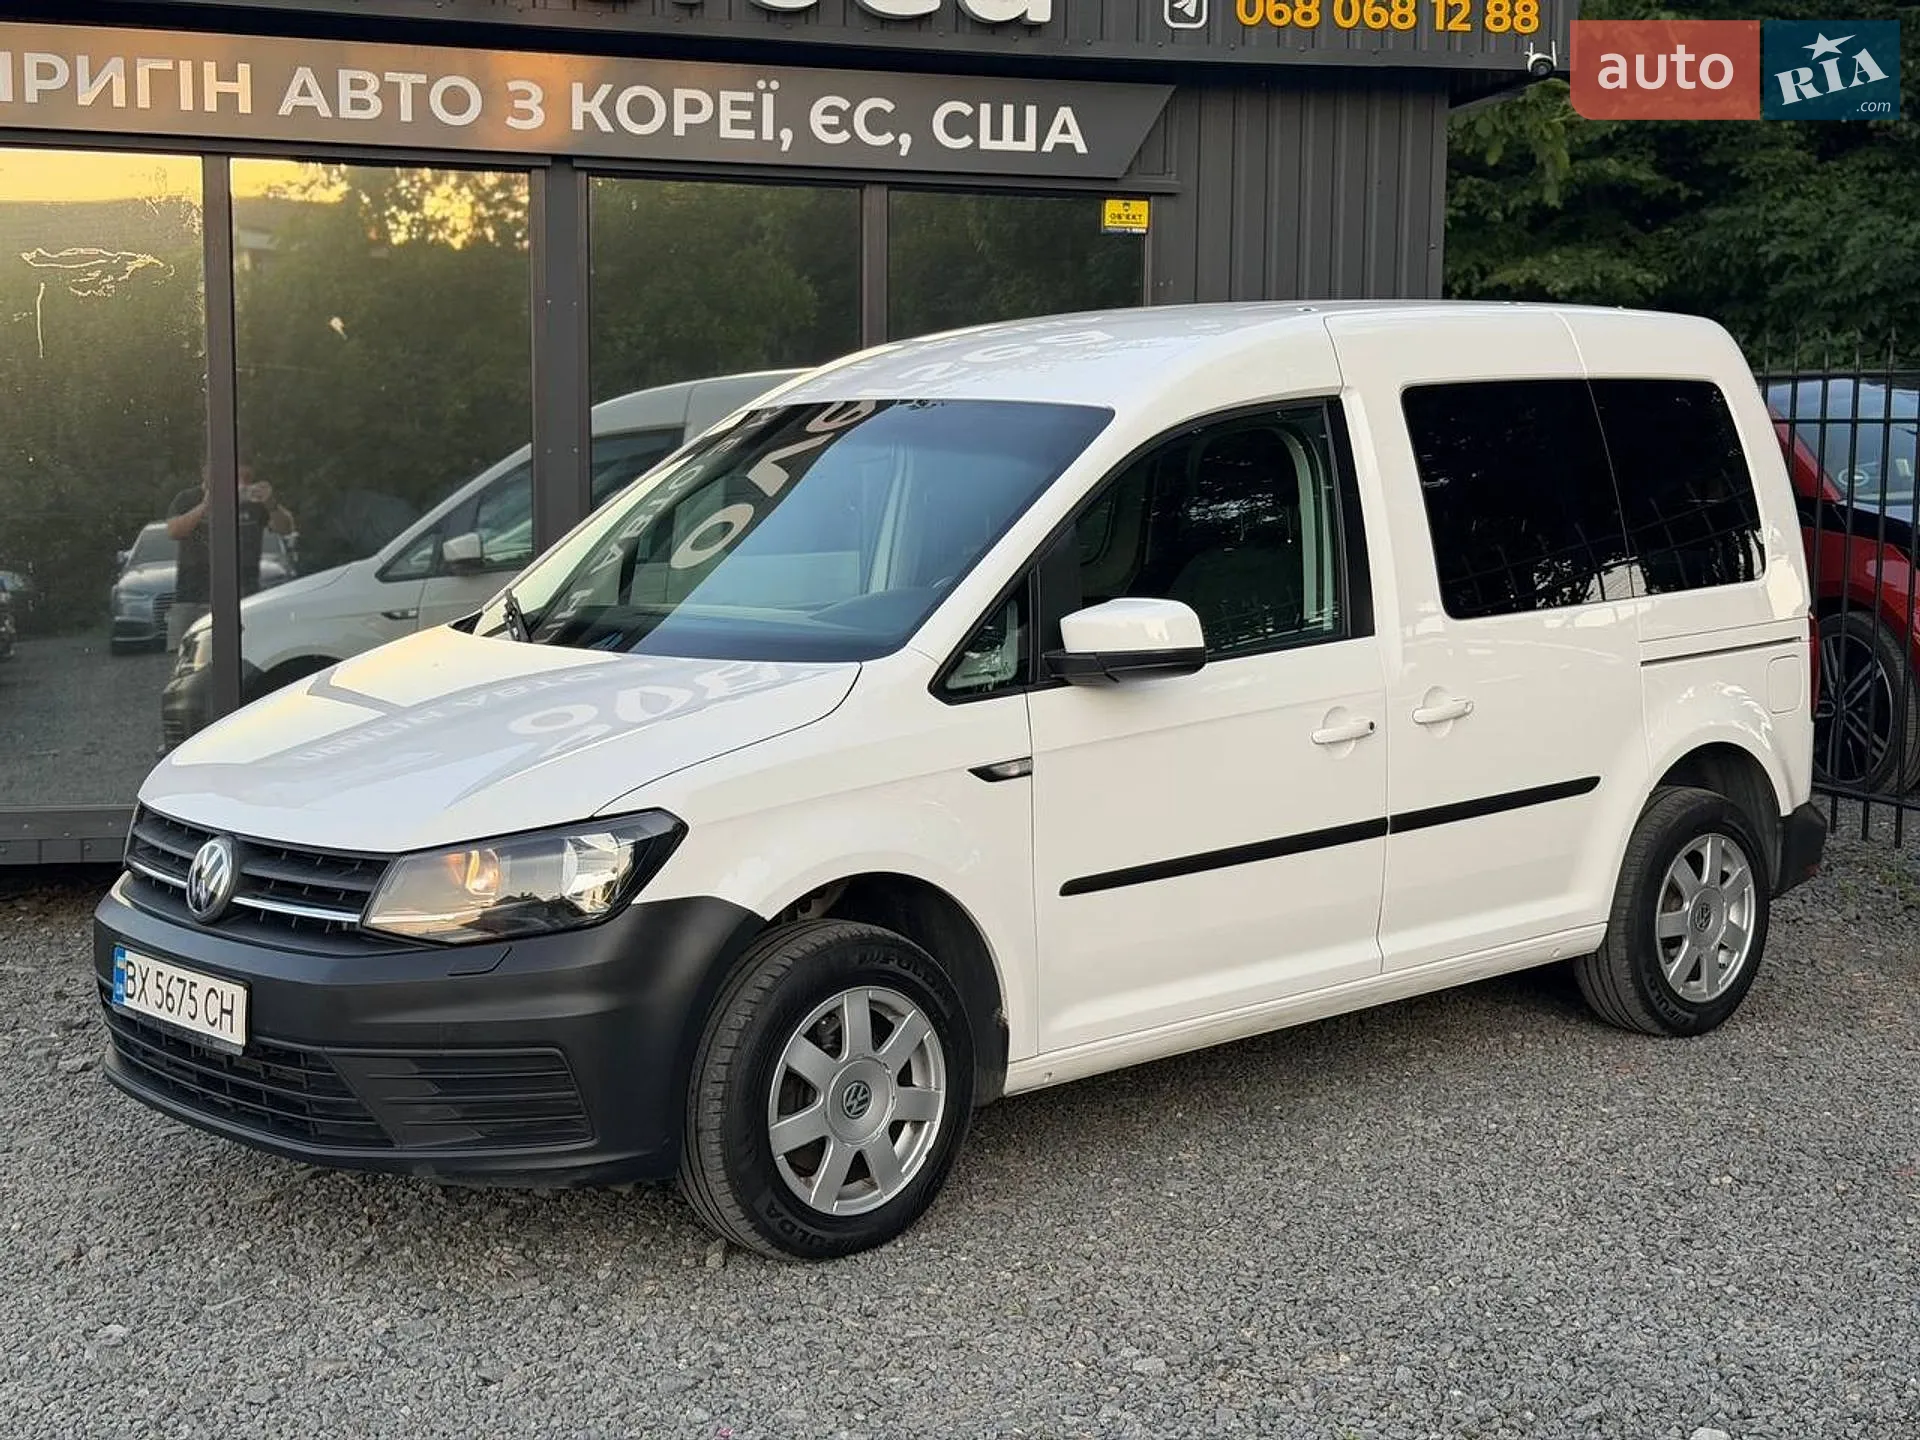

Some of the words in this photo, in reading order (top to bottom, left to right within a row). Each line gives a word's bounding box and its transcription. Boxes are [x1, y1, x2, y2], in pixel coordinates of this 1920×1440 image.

[1236, 0, 1320, 28] 068
[1333, 0, 1417, 30] 068
[1432, 0, 1471, 32] 12
[1485, 0, 1539, 33] 88
[0, 50, 252, 114] РИГІН
[278, 66, 483, 126] АВТО
[571, 79, 794, 152] КОРЕЇ,
[809, 95, 912, 157] ЄС,
[932, 100, 1089, 154] США
[125, 960, 150, 1006] BX
[154, 970, 198, 1021] 5675
[204, 987, 234, 1034] CH
